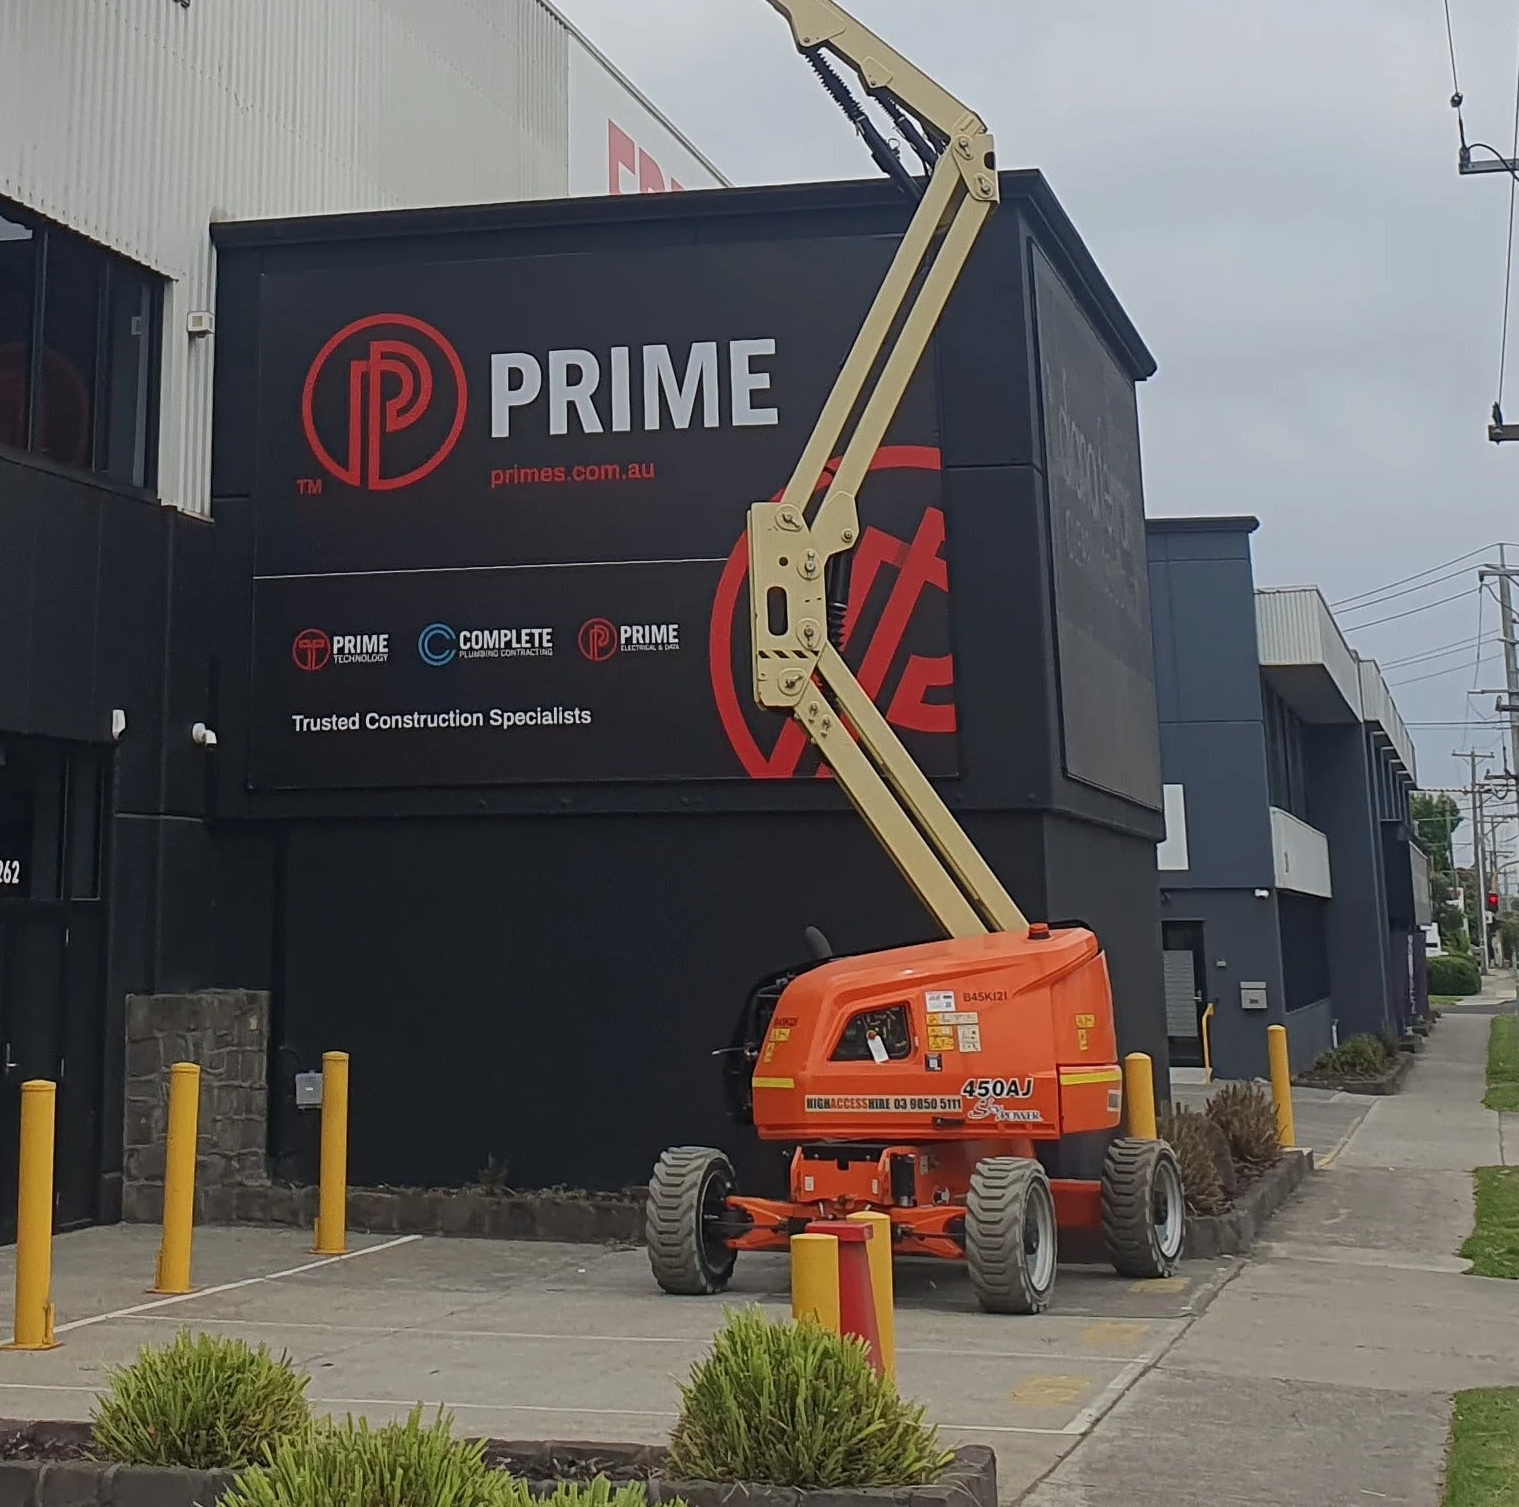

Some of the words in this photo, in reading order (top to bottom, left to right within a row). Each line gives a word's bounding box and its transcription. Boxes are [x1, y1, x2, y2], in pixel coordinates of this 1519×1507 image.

[490, 338, 779, 438] PRIME
[490, 460, 655, 488] primes.com.au
[296, 478, 322, 495] TM
[332, 634, 389, 654] PRIME
[459, 628, 553, 650] COMPLETE
[620, 624, 679, 644] PRIME
[334, 653, 389, 664] TECHNOLOGY
[292, 712, 360, 732] Trusted
[365, 709, 484, 729] Construction
[489, 706, 592, 729] Specialists
[961, 1078, 1034, 1099] 450AJ
[894, 1098, 909, 1110] 03
[940, 1098, 962, 1110] 5111
